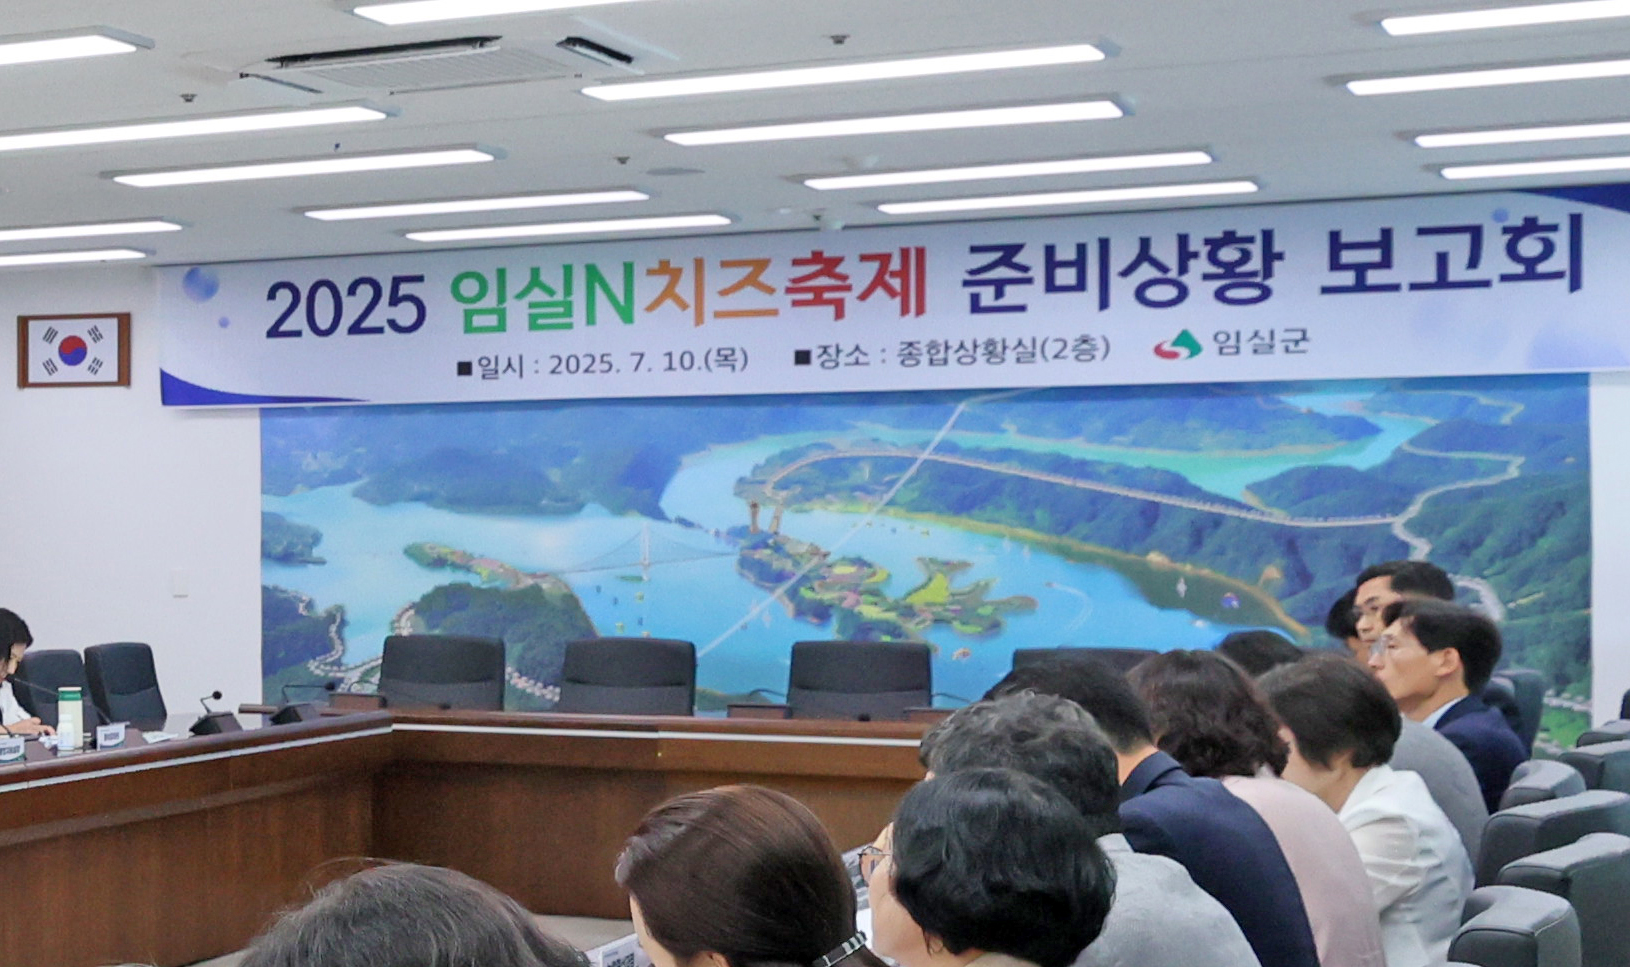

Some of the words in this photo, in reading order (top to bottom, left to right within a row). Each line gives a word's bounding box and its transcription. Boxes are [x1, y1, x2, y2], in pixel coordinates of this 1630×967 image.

[264, 274, 428, 339] 2025
[449, 246, 927, 335] 임실N치즈축제
[962, 228, 1286, 314] 준비상황
[1319, 213, 1586, 297] 보고회
[816, 342, 871, 369] 장소
[896, 334, 1112, 367] 종합상황실(2층)
[1213, 328, 1311, 359] 임실군
[476, 353, 525, 381] 일시
[548, 350, 620, 376] 2025.
[630, 350, 655, 374] 7.
[663, 346, 750, 374] 10.(목)
